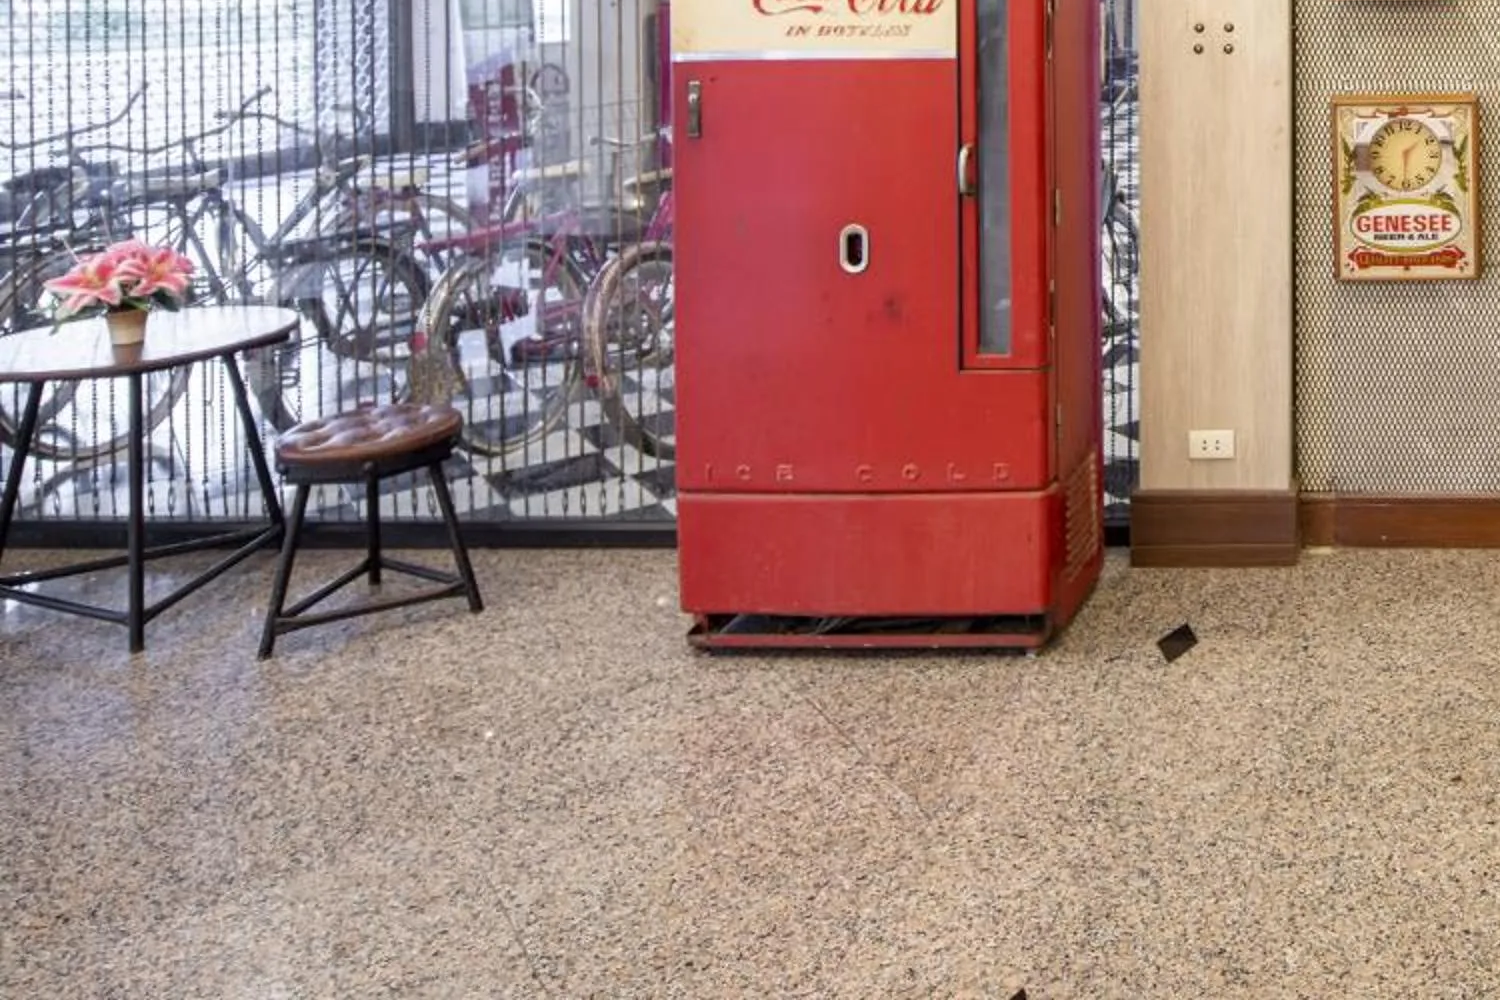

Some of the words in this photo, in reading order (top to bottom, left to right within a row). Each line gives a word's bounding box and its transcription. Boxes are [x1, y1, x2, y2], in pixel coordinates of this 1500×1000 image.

[786, 25, 811, 36] IN
[1357, 214, 1452, 232] GENESEE
[703, 463, 795, 481] ICE
